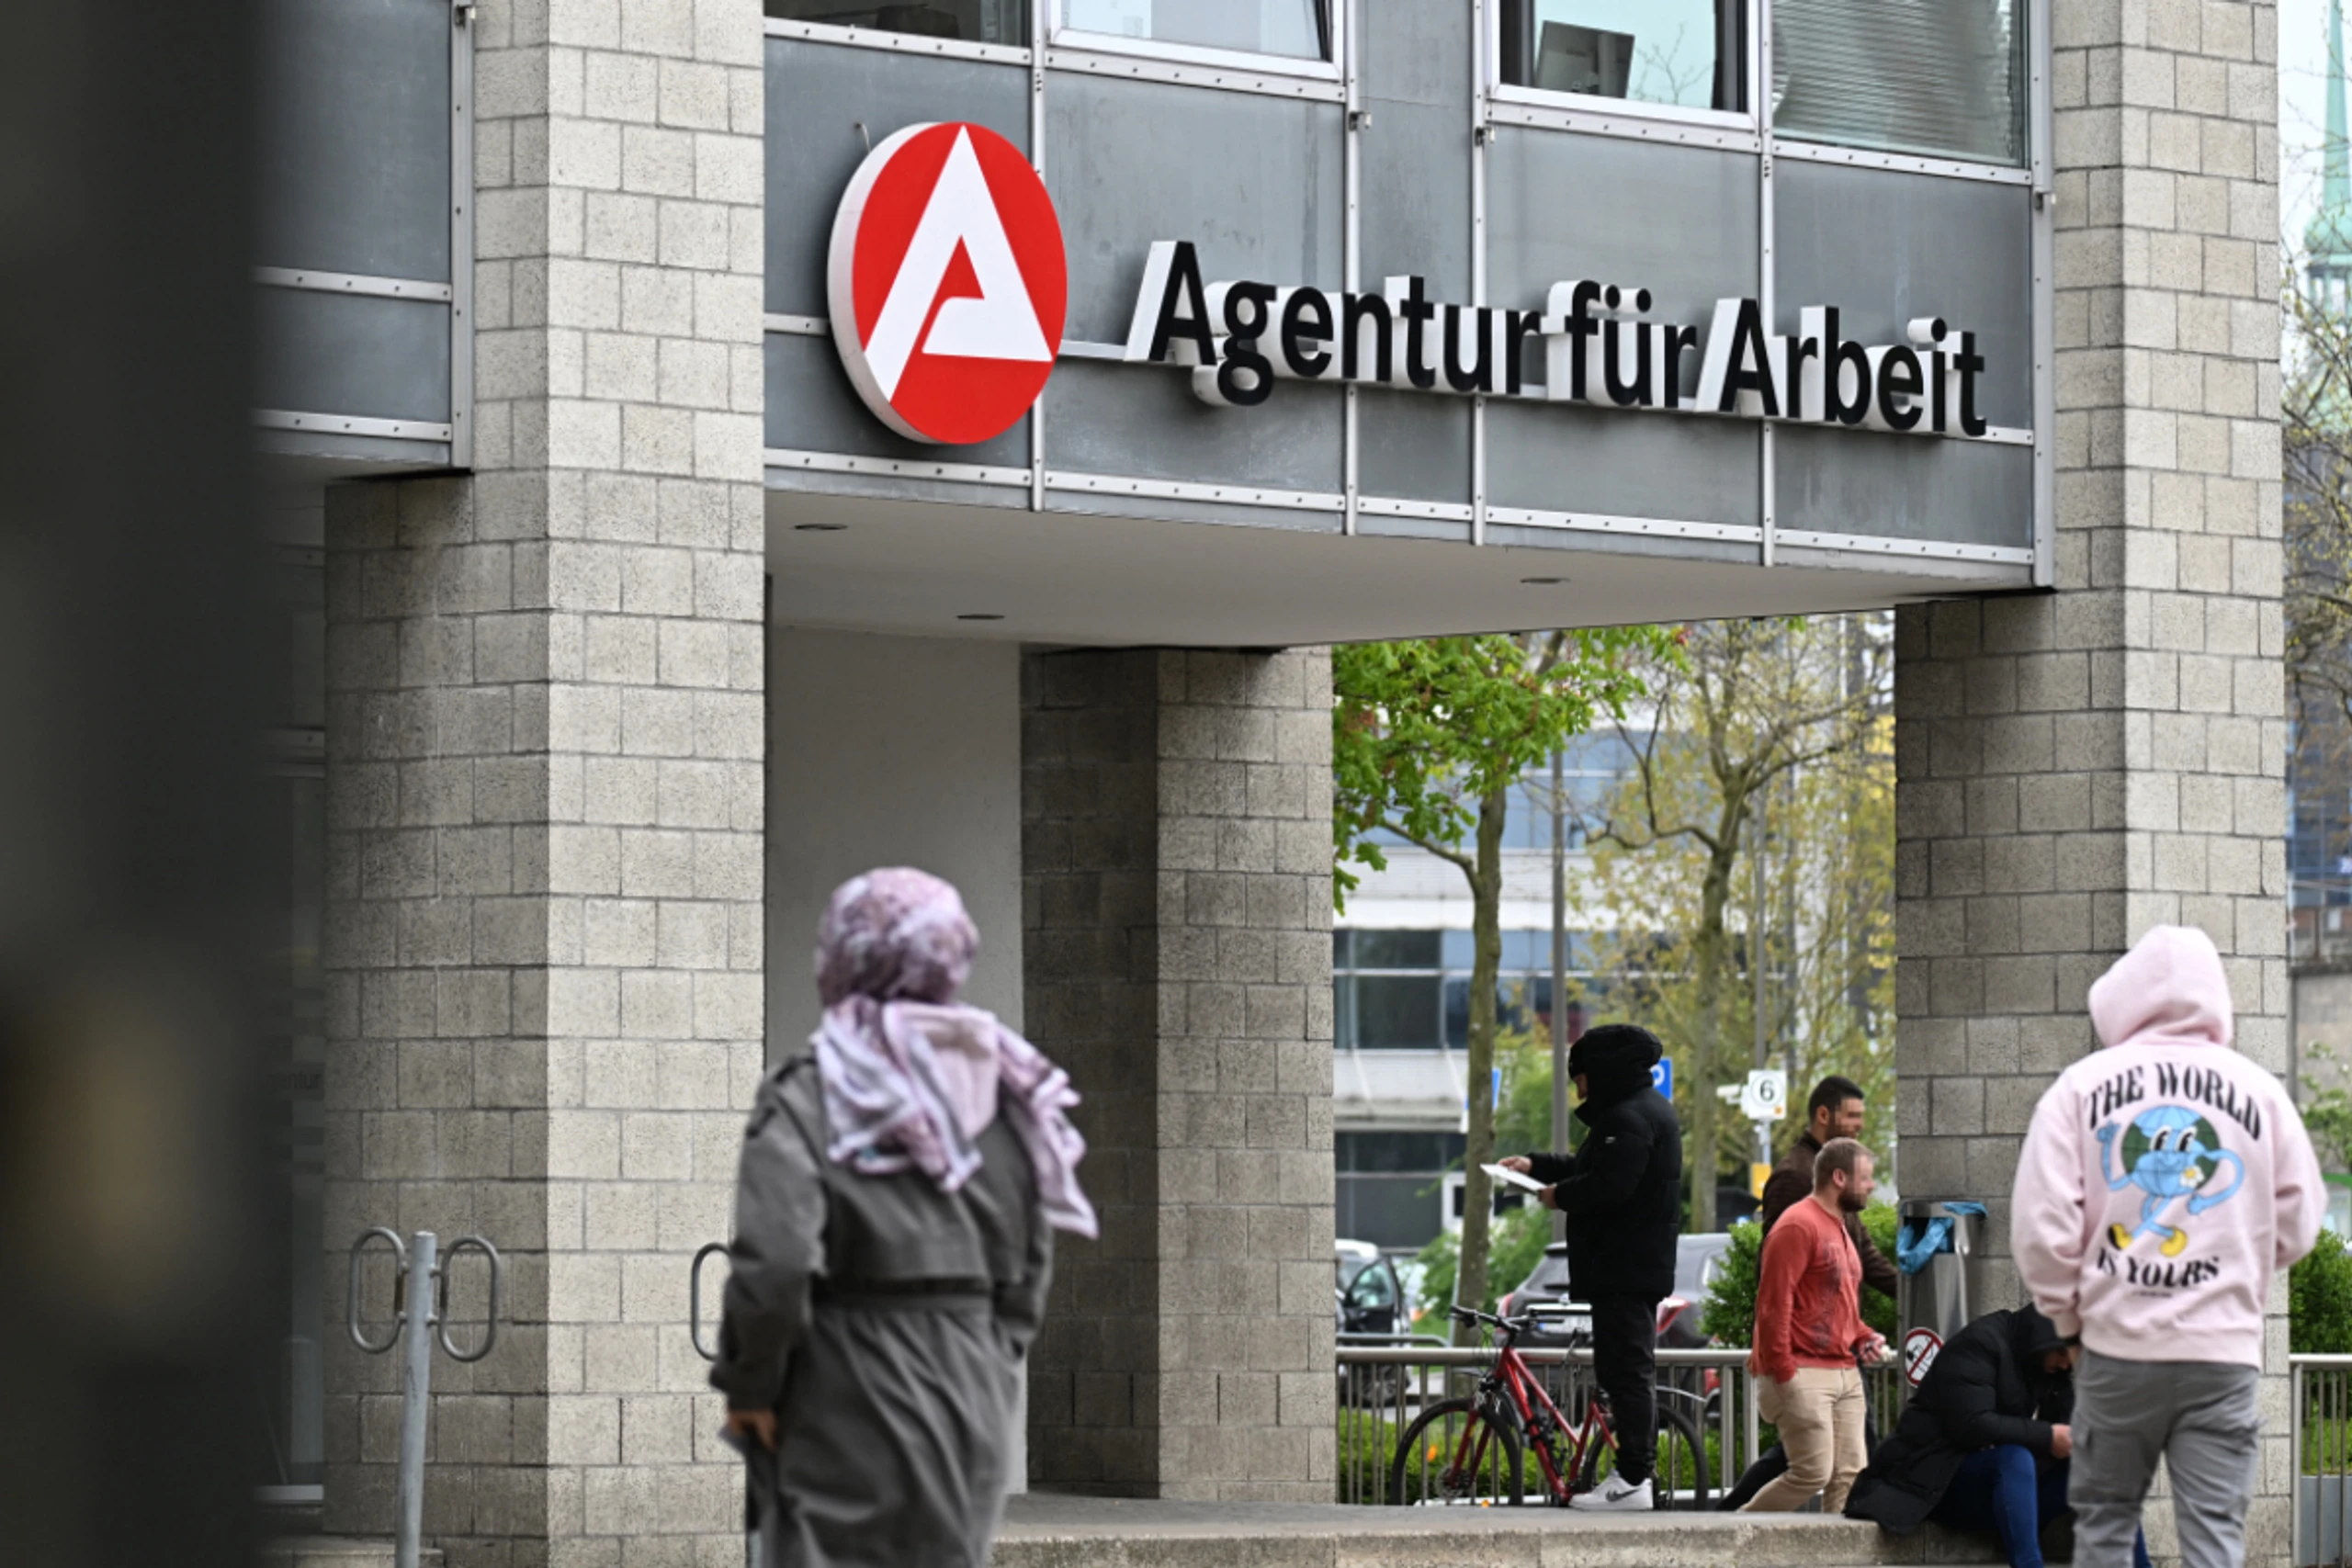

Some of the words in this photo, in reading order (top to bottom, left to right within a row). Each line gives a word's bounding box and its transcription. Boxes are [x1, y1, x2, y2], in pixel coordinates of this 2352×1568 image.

[1148, 240, 1541, 407] Agentur
[1562, 279, 1697, 410] für
[1717, 298, 1986, 436] Arbeit
[1759, 1079, 1774, 1102] 6
[2084, 1065, 2143, 1131] THE
[2154, 1062, 2262, 1141] WORLD
[2098, 1247, 2119, 1277] IS
[2126, 1255, 2220, 1288] YOURS
